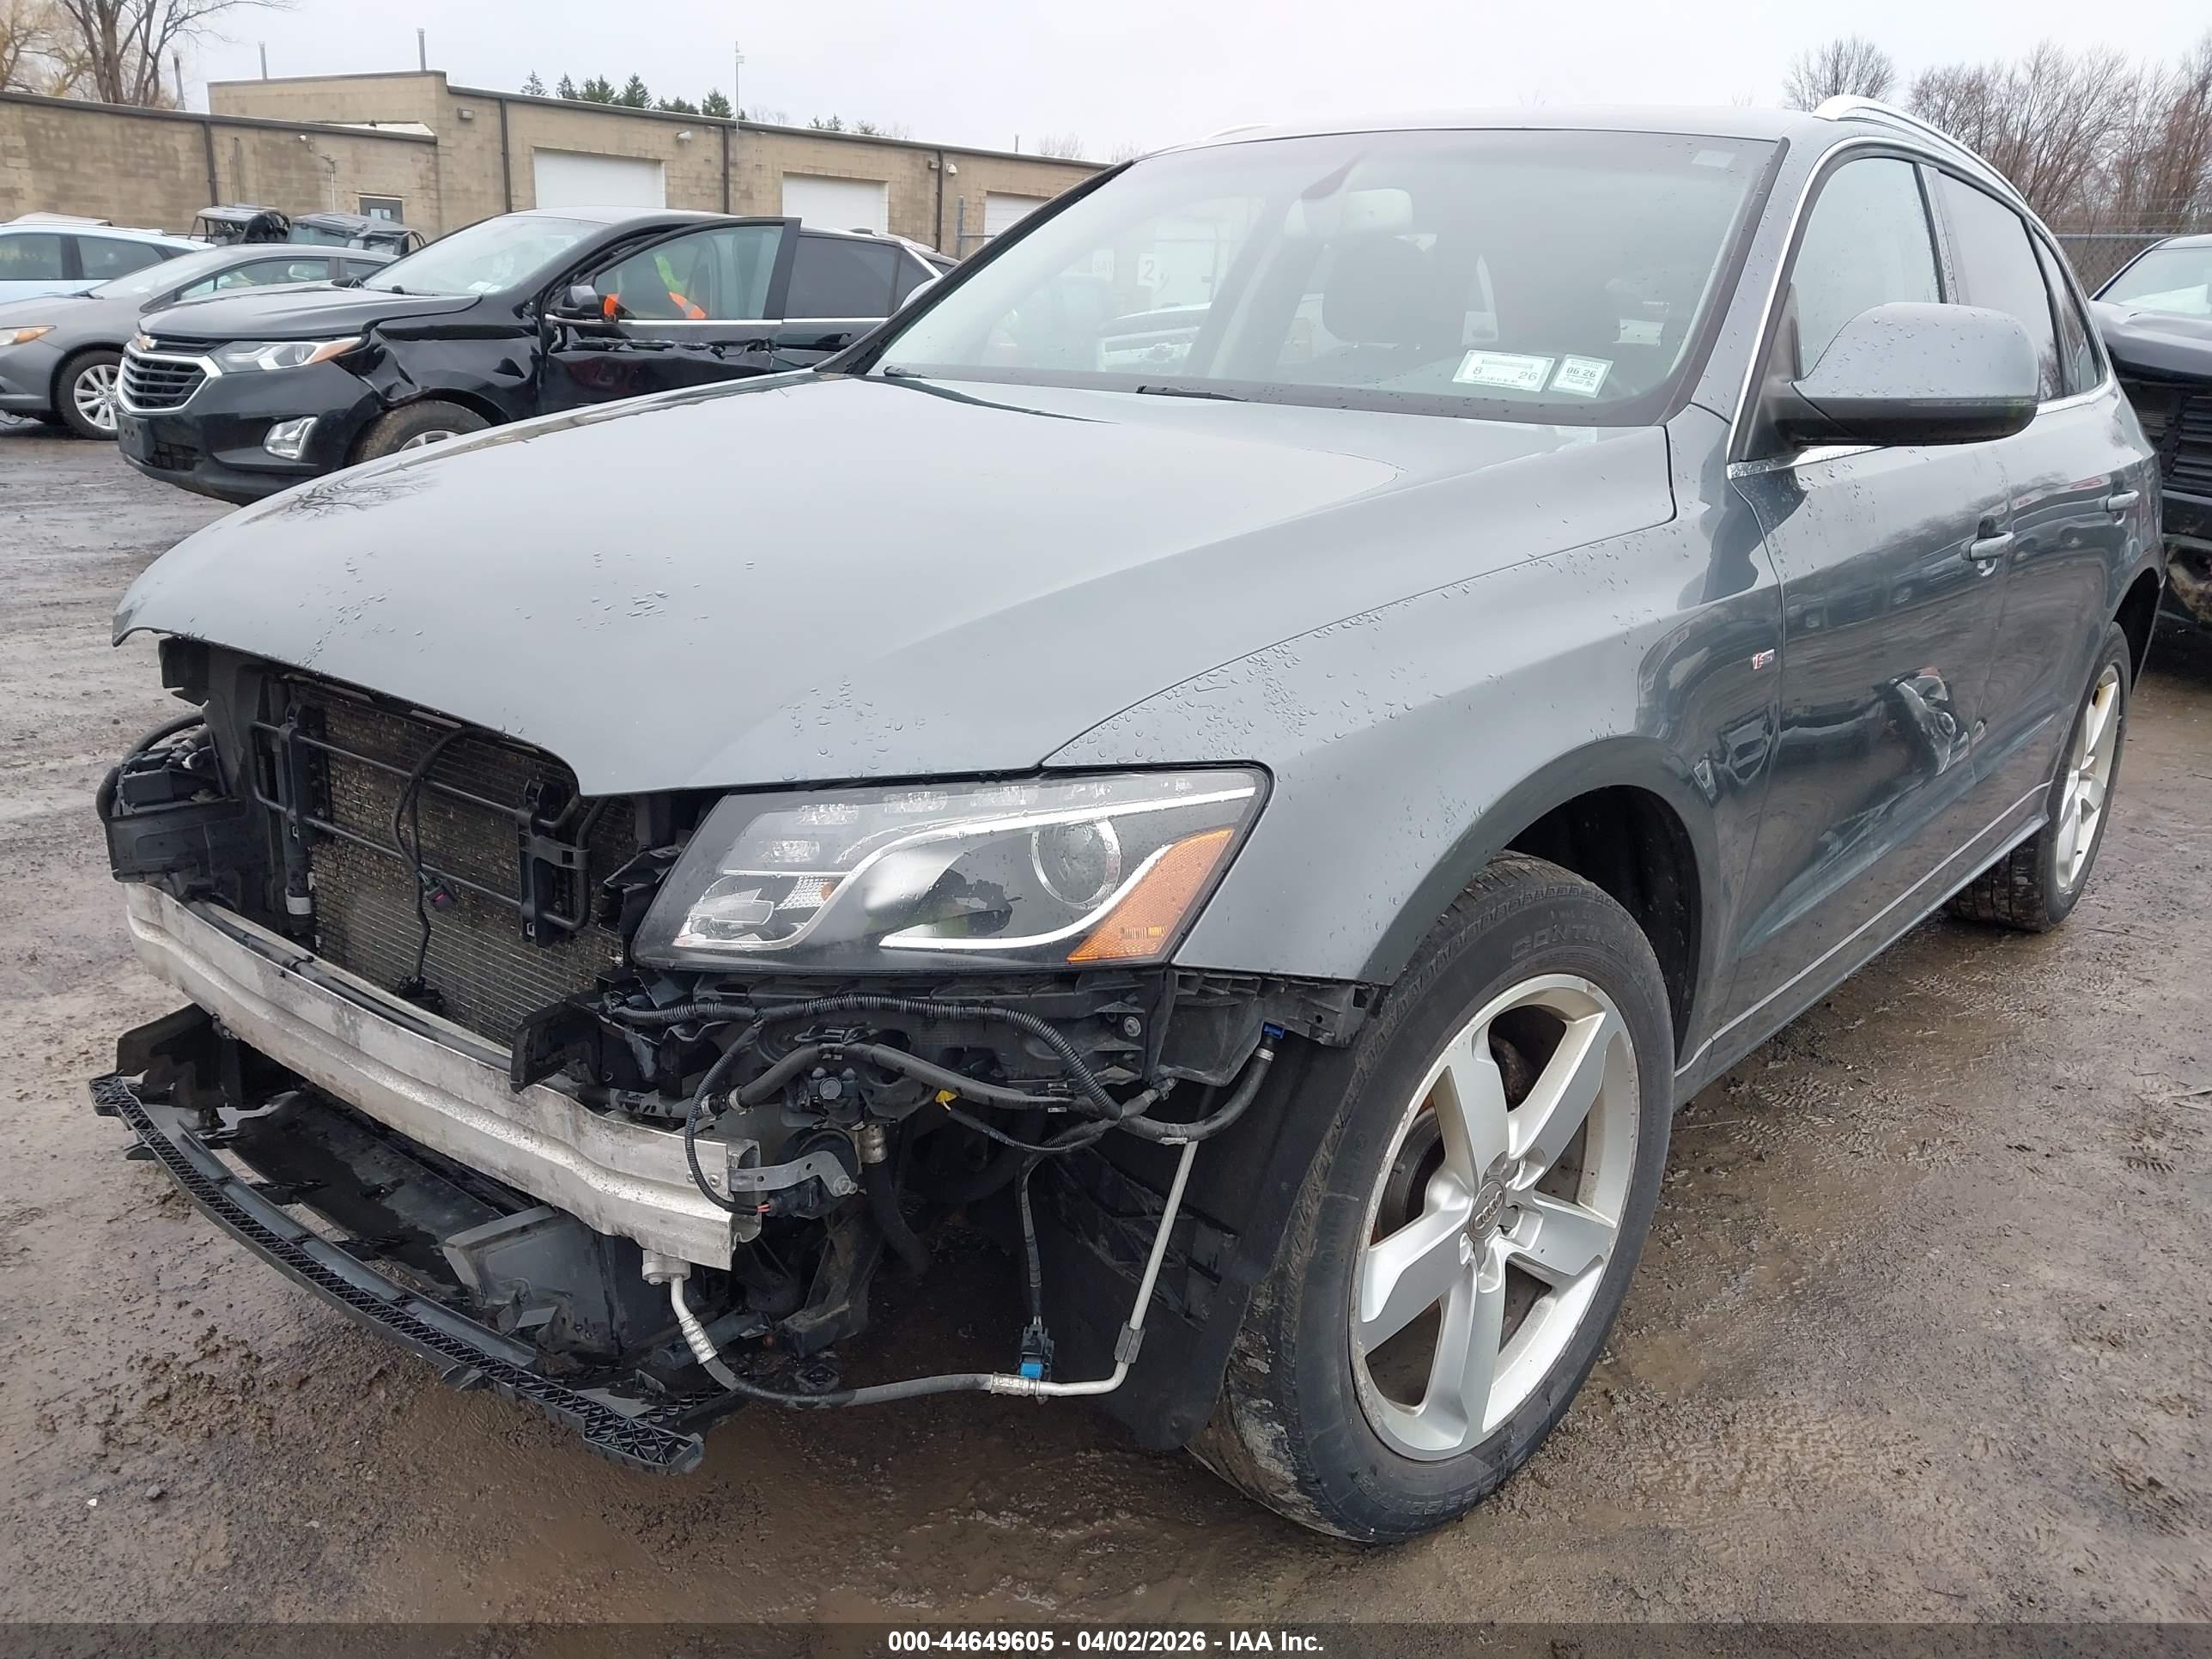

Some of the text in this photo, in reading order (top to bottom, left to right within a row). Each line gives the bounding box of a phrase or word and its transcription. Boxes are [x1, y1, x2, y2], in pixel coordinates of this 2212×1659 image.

[1143, 259, 1155, 281] 2
[1473, 366, 1483, 375] 8
[1518, 371, 1538, 381] 26
[1566, 367, 1597, 378] 06 26
